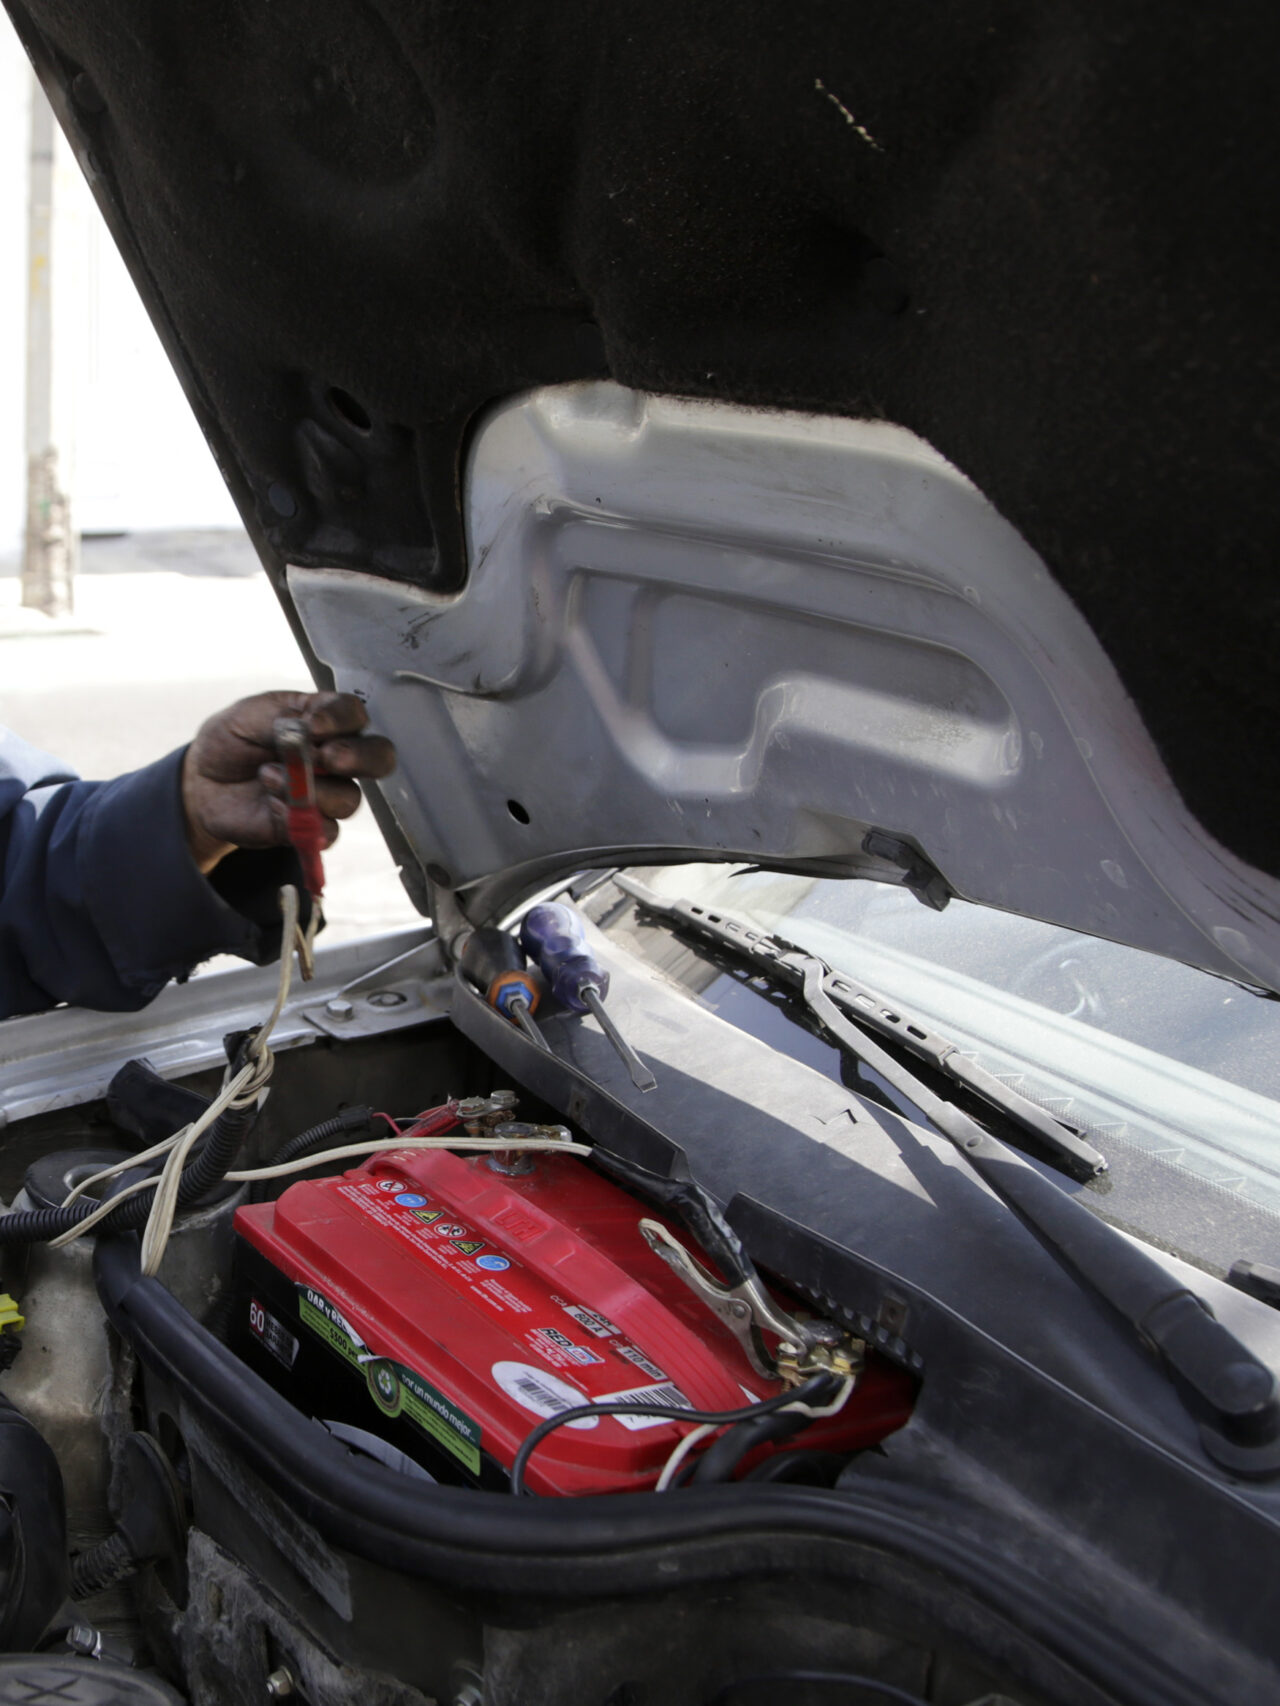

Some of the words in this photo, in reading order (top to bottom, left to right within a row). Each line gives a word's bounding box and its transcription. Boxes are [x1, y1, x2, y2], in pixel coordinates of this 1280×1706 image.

[250, 1302, 264, 1333] 60
[540, 1328, 571, 1348] RED
[414, 1382, 424, 1398] un
[423, 1387, 449, 1419] mundo
